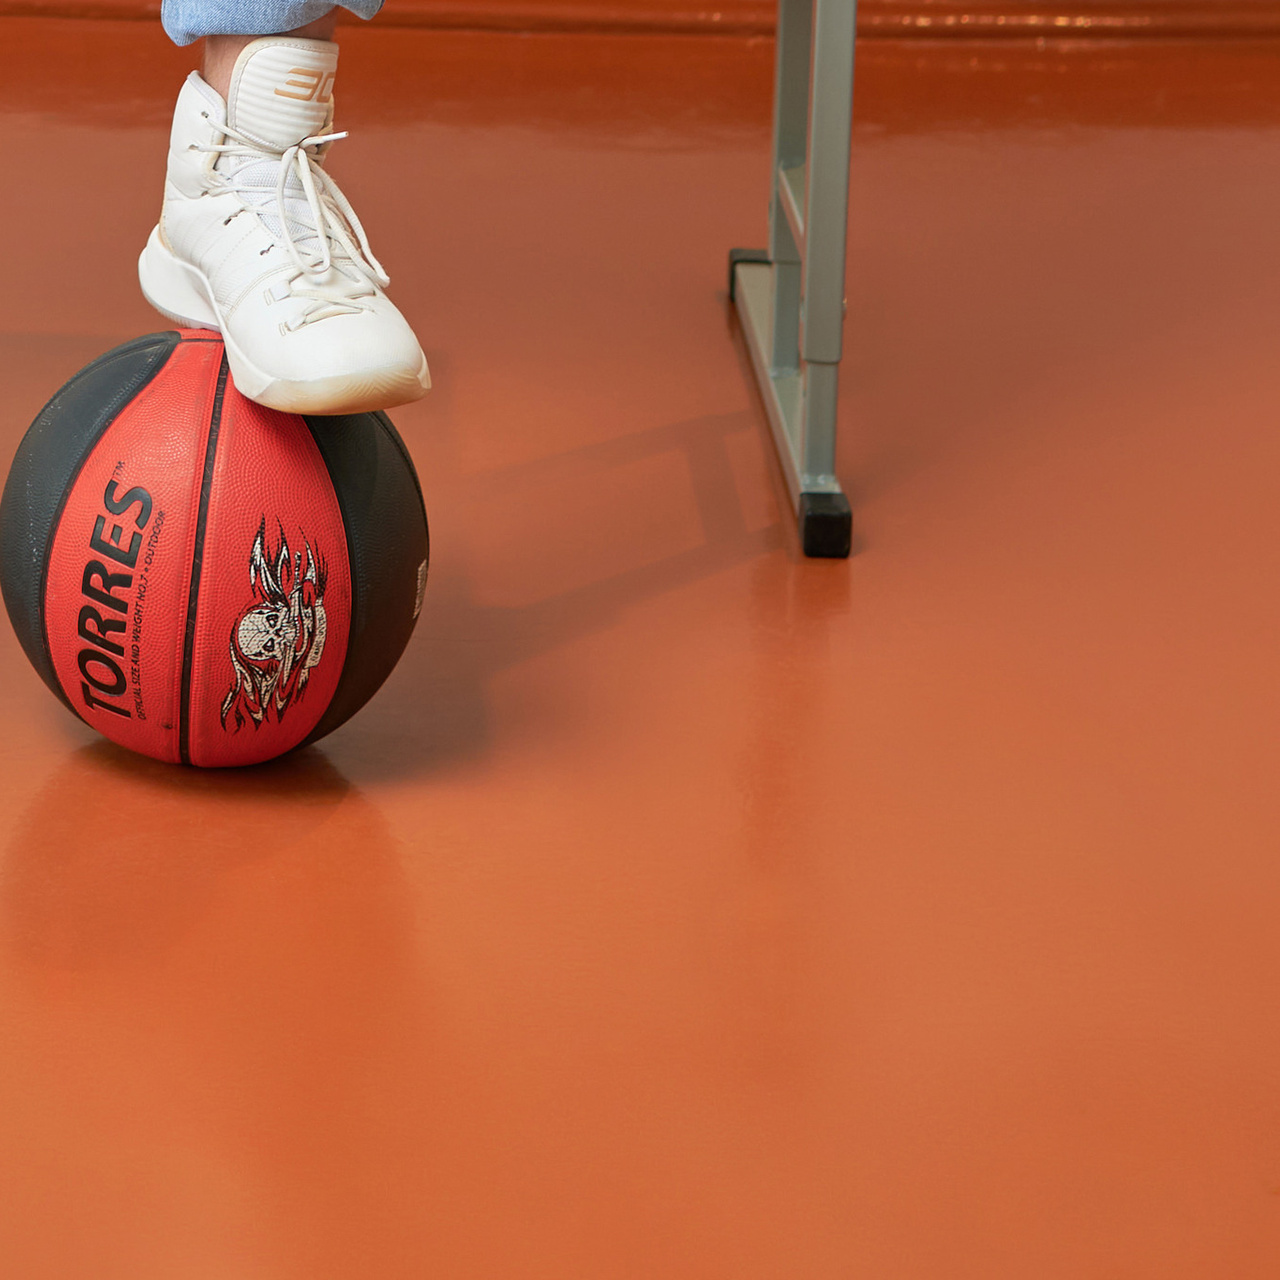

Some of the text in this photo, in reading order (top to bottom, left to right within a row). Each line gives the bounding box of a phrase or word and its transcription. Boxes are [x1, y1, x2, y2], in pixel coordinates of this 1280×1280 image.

[143, 510, 166, 566] OUTDOOR
[77, 478, 153, 720] TORRES
[131, 602, 145, 643] WEIGHT
[130, 644, 141, 667] AND
[131, 666, 141, 686] SIZE
[131, 686, 146, 721] OFFICIAL
